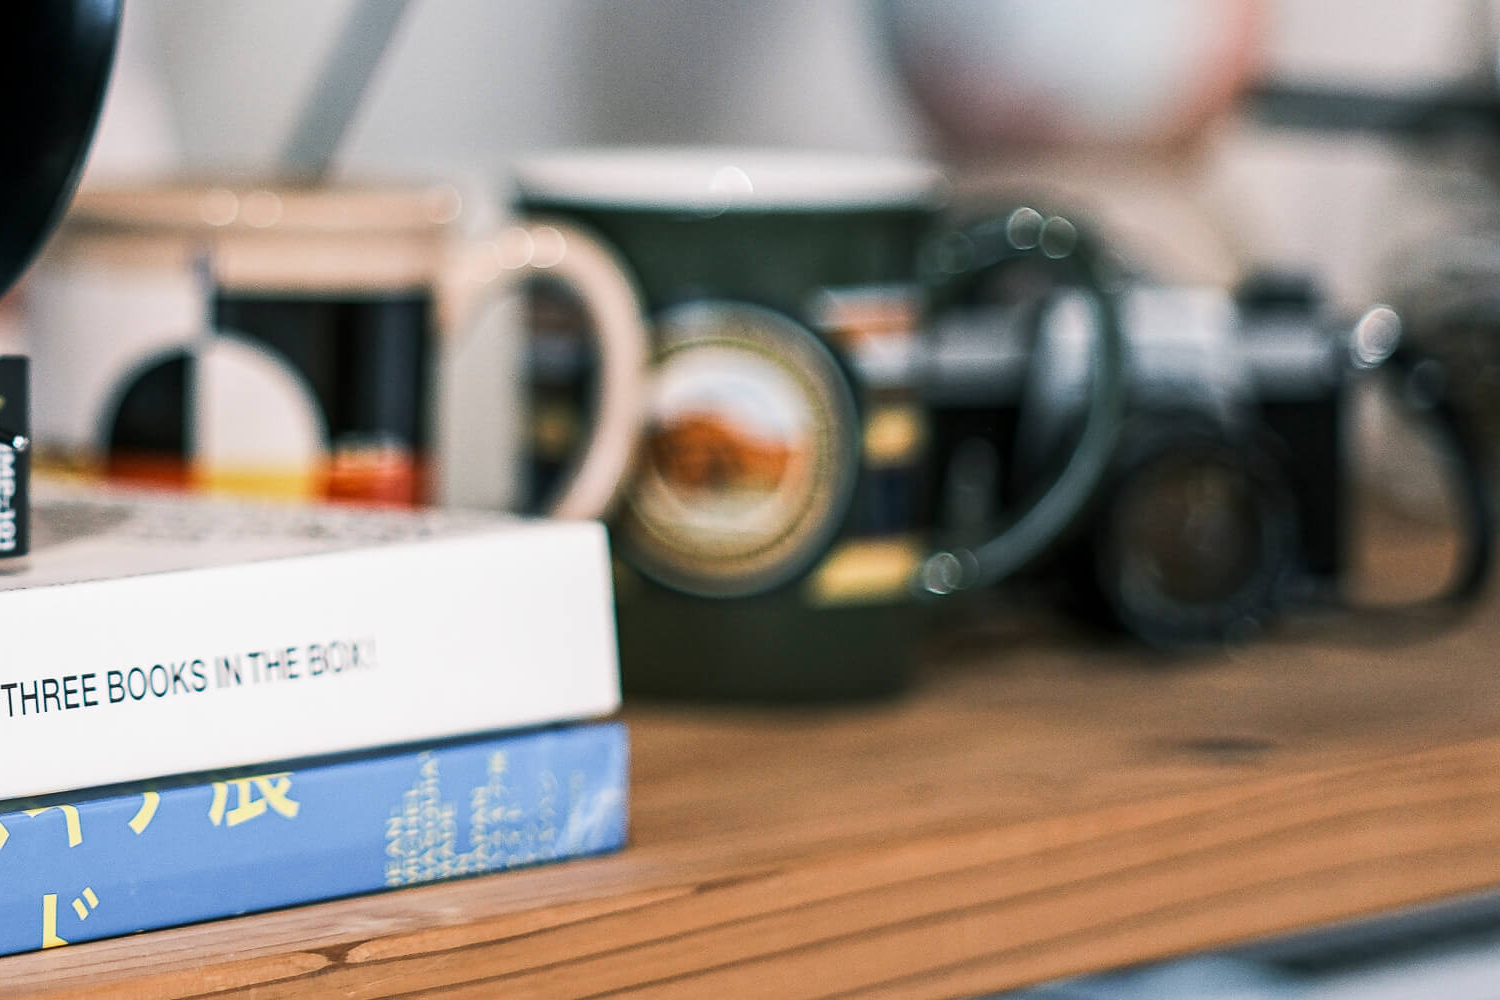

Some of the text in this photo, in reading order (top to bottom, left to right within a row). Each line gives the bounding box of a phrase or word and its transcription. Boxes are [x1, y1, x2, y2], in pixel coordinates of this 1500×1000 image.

[106, 658, 208, 705] BOOKS
[215, 654, 243, 690] IN
[247, 646, 299, 686] THE
